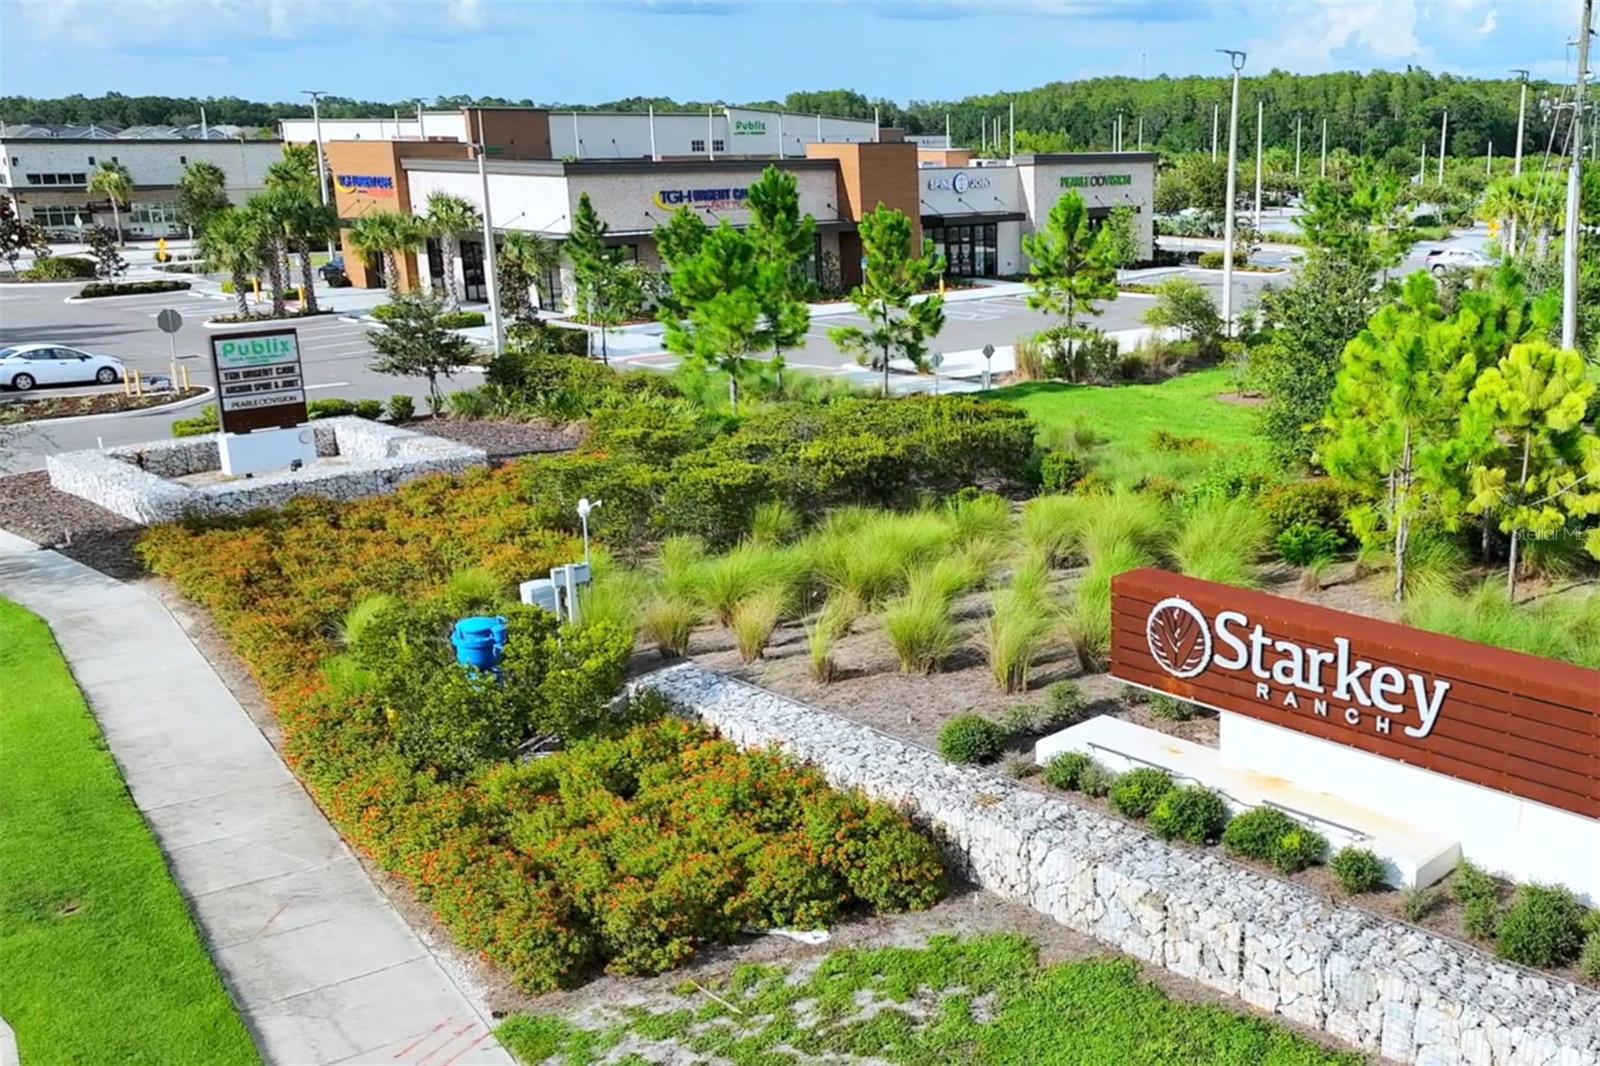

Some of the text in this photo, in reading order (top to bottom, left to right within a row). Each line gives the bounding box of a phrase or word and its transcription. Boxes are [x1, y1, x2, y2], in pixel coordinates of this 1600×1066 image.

[660, 190, 692, 204] TGH
[222, 338, 290, 356] Publix
[1213, 611, 1450, 739] Starkey
[1256, 682, 1391, 735] RANCH
